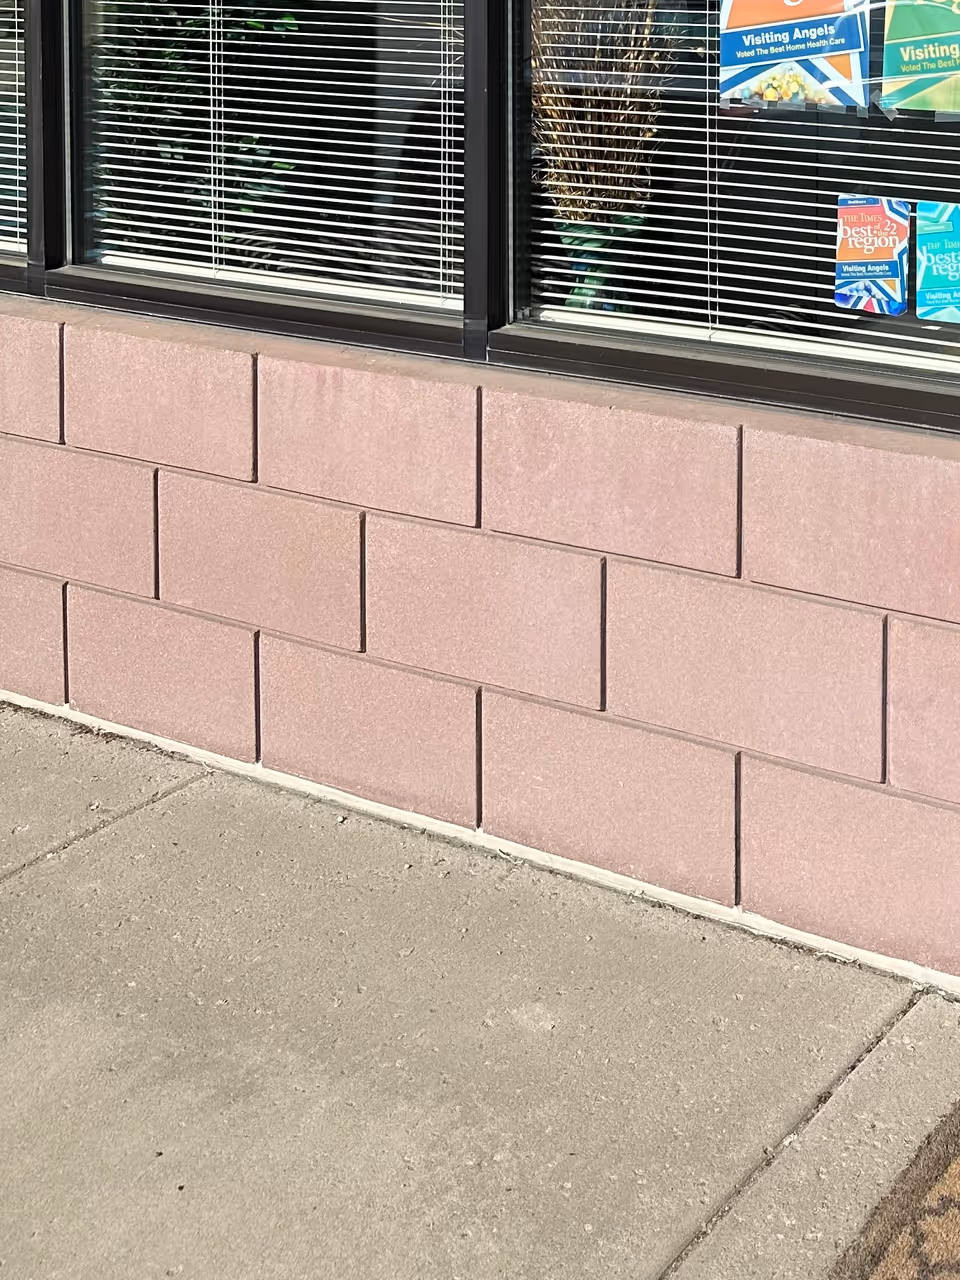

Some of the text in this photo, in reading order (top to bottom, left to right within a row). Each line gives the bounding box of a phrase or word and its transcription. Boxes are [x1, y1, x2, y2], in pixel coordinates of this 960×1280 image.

[742, 23, 836, 47] Visiting Angels
[735, 37, 846, 59] Voted The Best Home Health Care
[899, 42, 960, 62] Visiting
[900, 63, 922, 74] Voted
[922, 61, 937, 71] The
[937, 58, 955, 69] Best
[838, 217, 874, 239] best
[847, 234, 899, 255] region
[921, 246, 959, 266] best
[842, 263, 890, 273] Visiting Angels
[925, 291, 952, 301] Visiting
